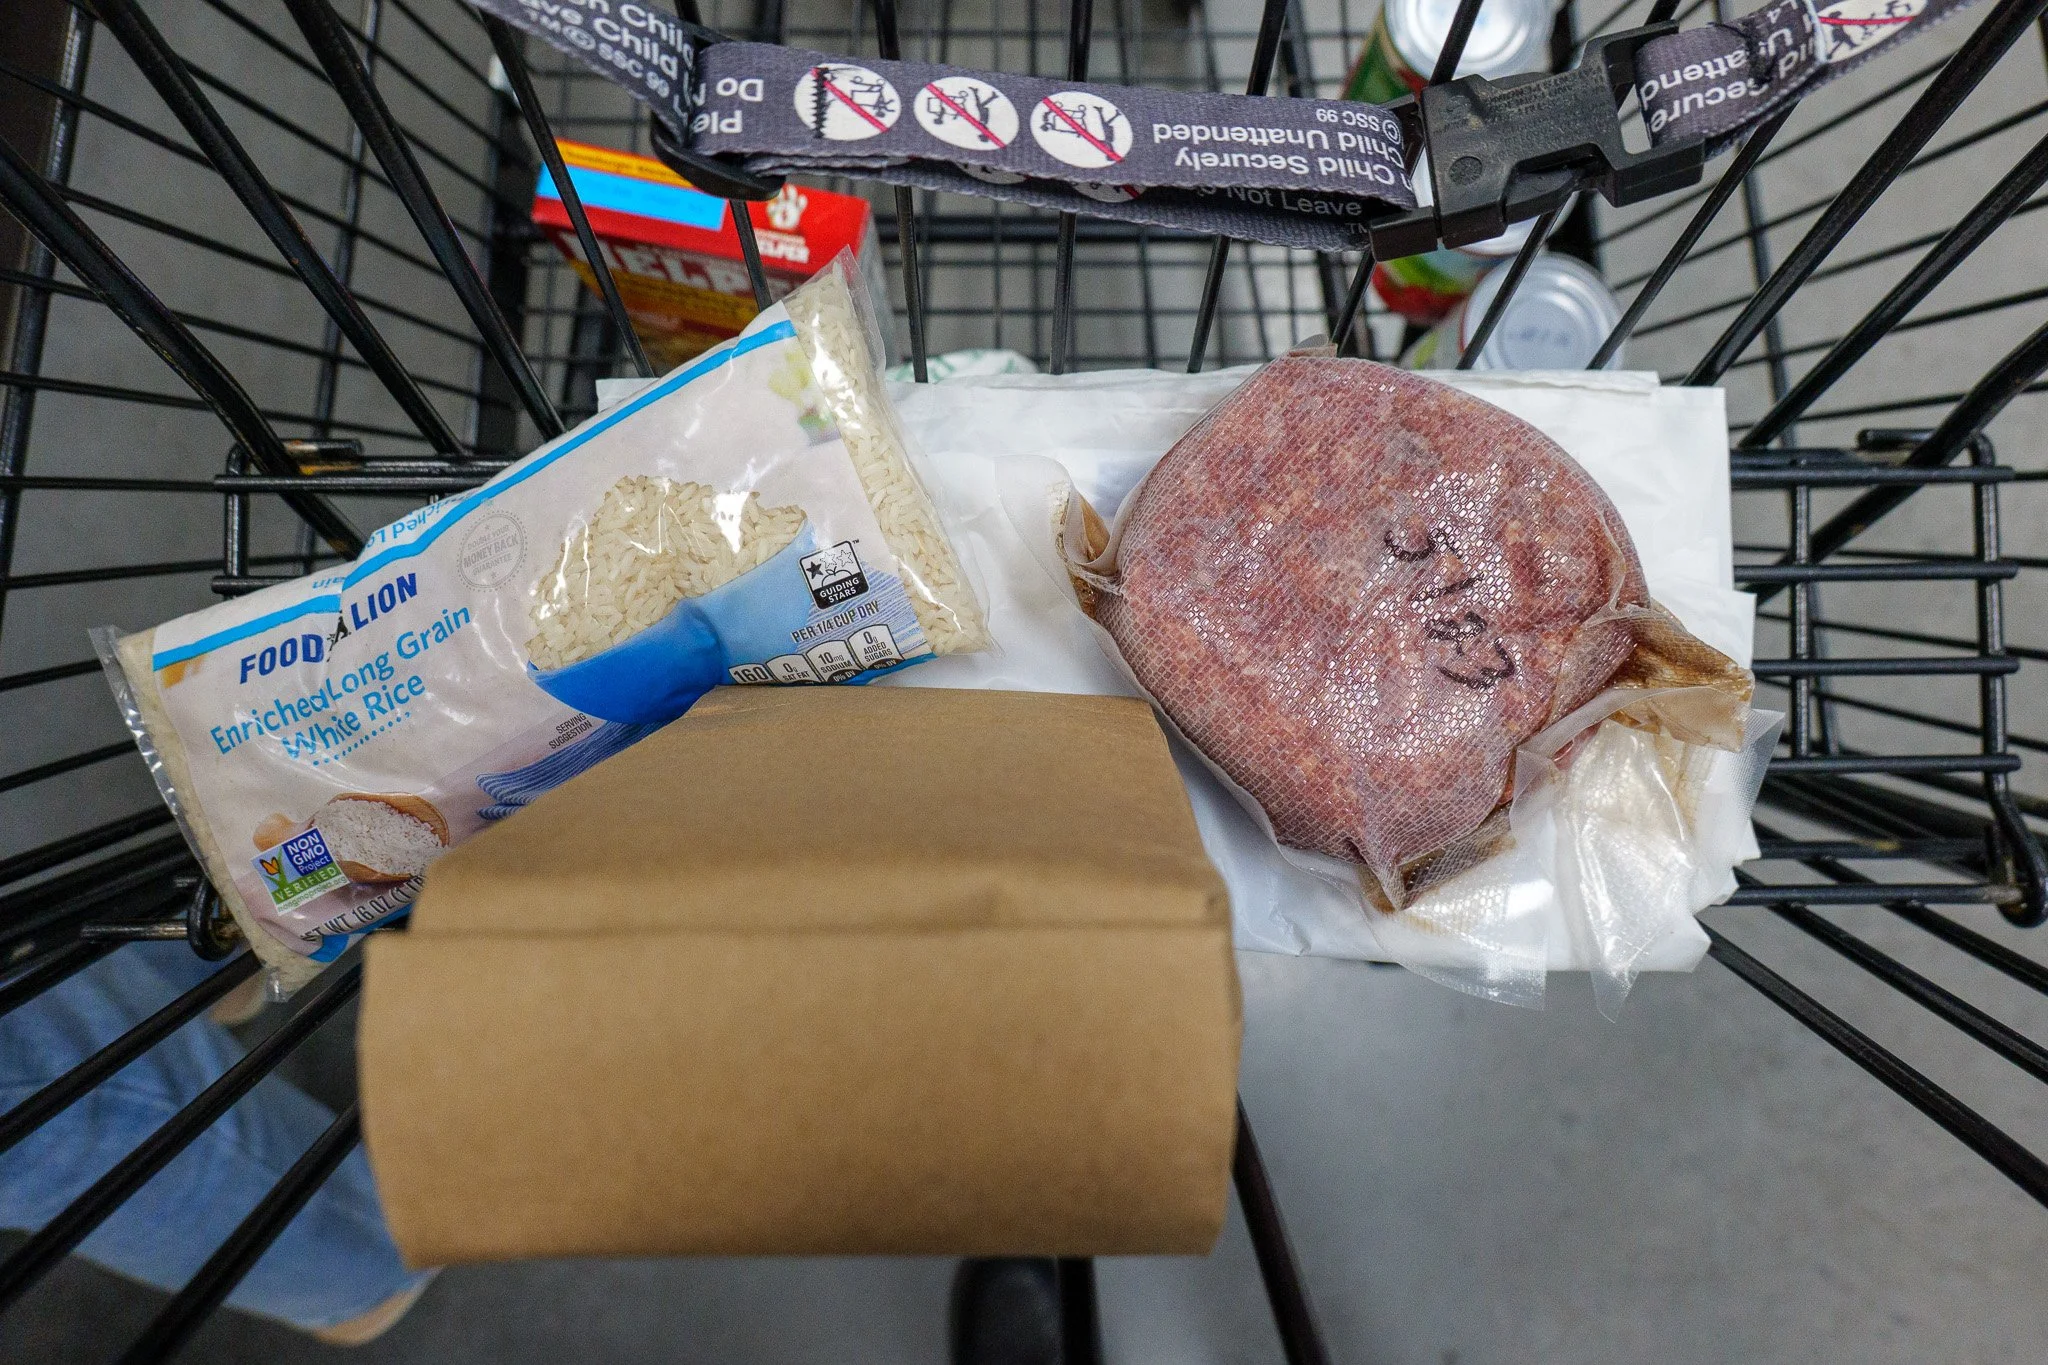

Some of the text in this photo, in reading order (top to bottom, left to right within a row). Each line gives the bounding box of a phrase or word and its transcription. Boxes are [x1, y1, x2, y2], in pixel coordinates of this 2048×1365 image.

[593, 17, 678, 80] Child
[598, 42, 644, 79] SSC
[646, 71, 670, 99] 99
[716, 77, 764, 103] Do
[1316, 108, 1339, 123] 99
[1342, 110, 1380, 132] SSC
[1152, 122, 1406, 169] Child Unattended
[1174, 147, 1310, 175] Securely
[1318, 155, 1396, 186] Child
[1281, 191, 1363, 217] Leave
[463, 534, 519, 568] MONEY BACK
[819, 577, 860, 598] GUIDING
[828, 586, 857, 603] STARS
[239, 572, 418, 685] FOOD LION
[791, 600, 881, 643] PER 1/4 CUP DRY
[863, 641, 887, 655] ADDED
[864, 648, 893, 662] SUGARS
[733, 666, 768, 683] 160
[782, 670, 810, 681] SAT FAT
[820, 660, 853, 674] SODIUM
[210, 606, 471, 756] Enriched Long Grain
[281, 673, 426, 760] White Rice
[555, 712, 587, 734] SERVING
[548, 720, 593, 750] SUGGESTION
[287, 832, 320, 856] NON
[292, 844, 325, 866] GMO
[298, 855, 330, 874] Project
[275, 867, 337, 900] VERIFIED
[324, 913, 353, 934] WT
[352, 905, 374, 923] 16
[369, 895, 396, 914] OZ
